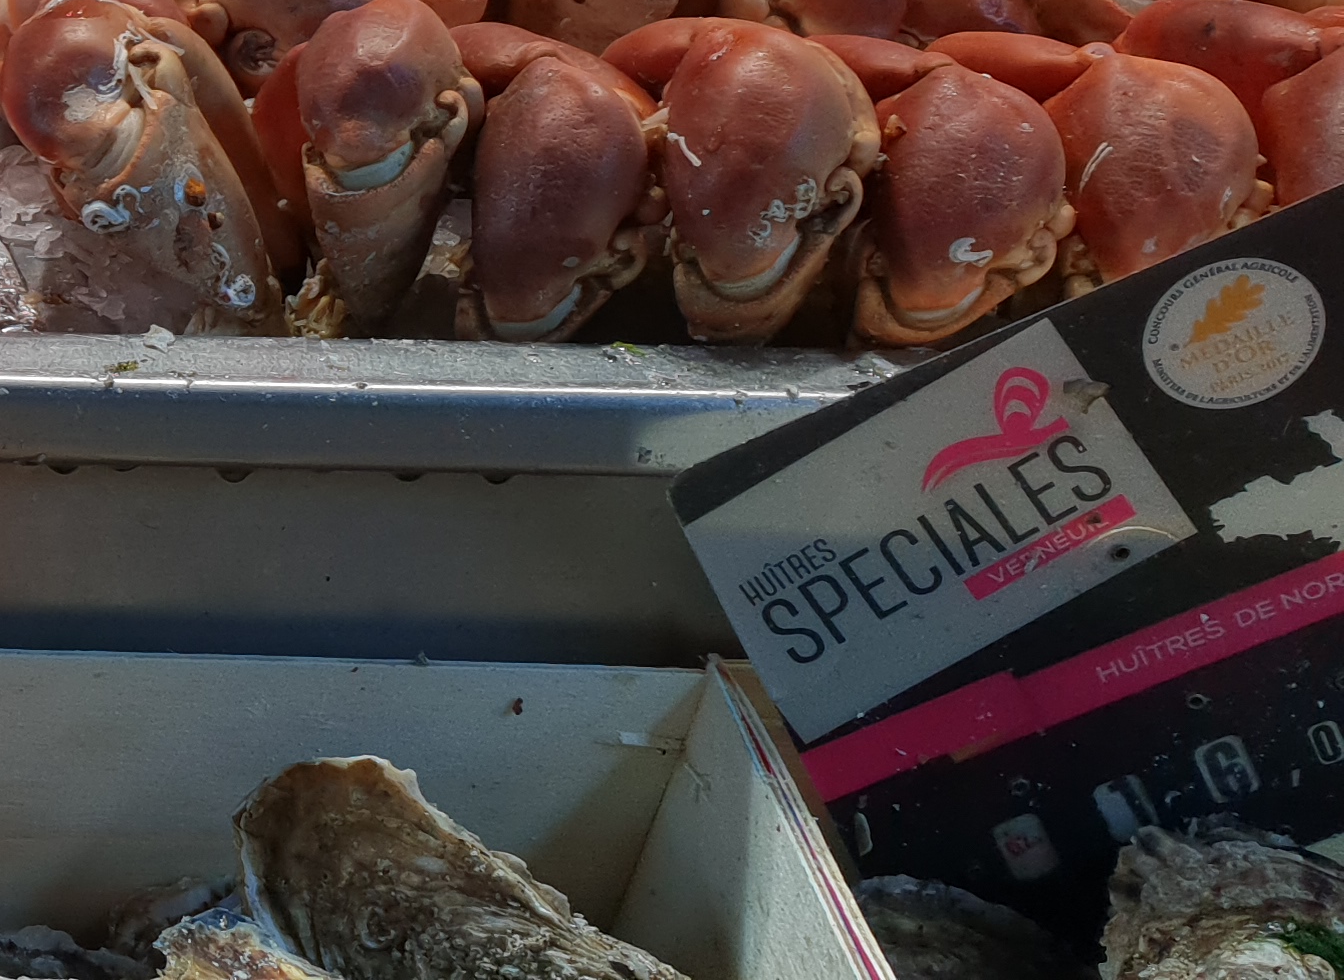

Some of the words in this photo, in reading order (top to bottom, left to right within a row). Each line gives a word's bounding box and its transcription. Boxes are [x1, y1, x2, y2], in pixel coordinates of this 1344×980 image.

[1148, 290, 1183, 344] CONCOURS
[739, 539, 837, 606] HUÎTRES
[761, 435, 1113, 665] SPECIALES
[987, 514, 1108, 584] VERNEUIL
[1096, 615, 1226, 684] HUÎTRES
[1234, 600, 1276, 628] DE
